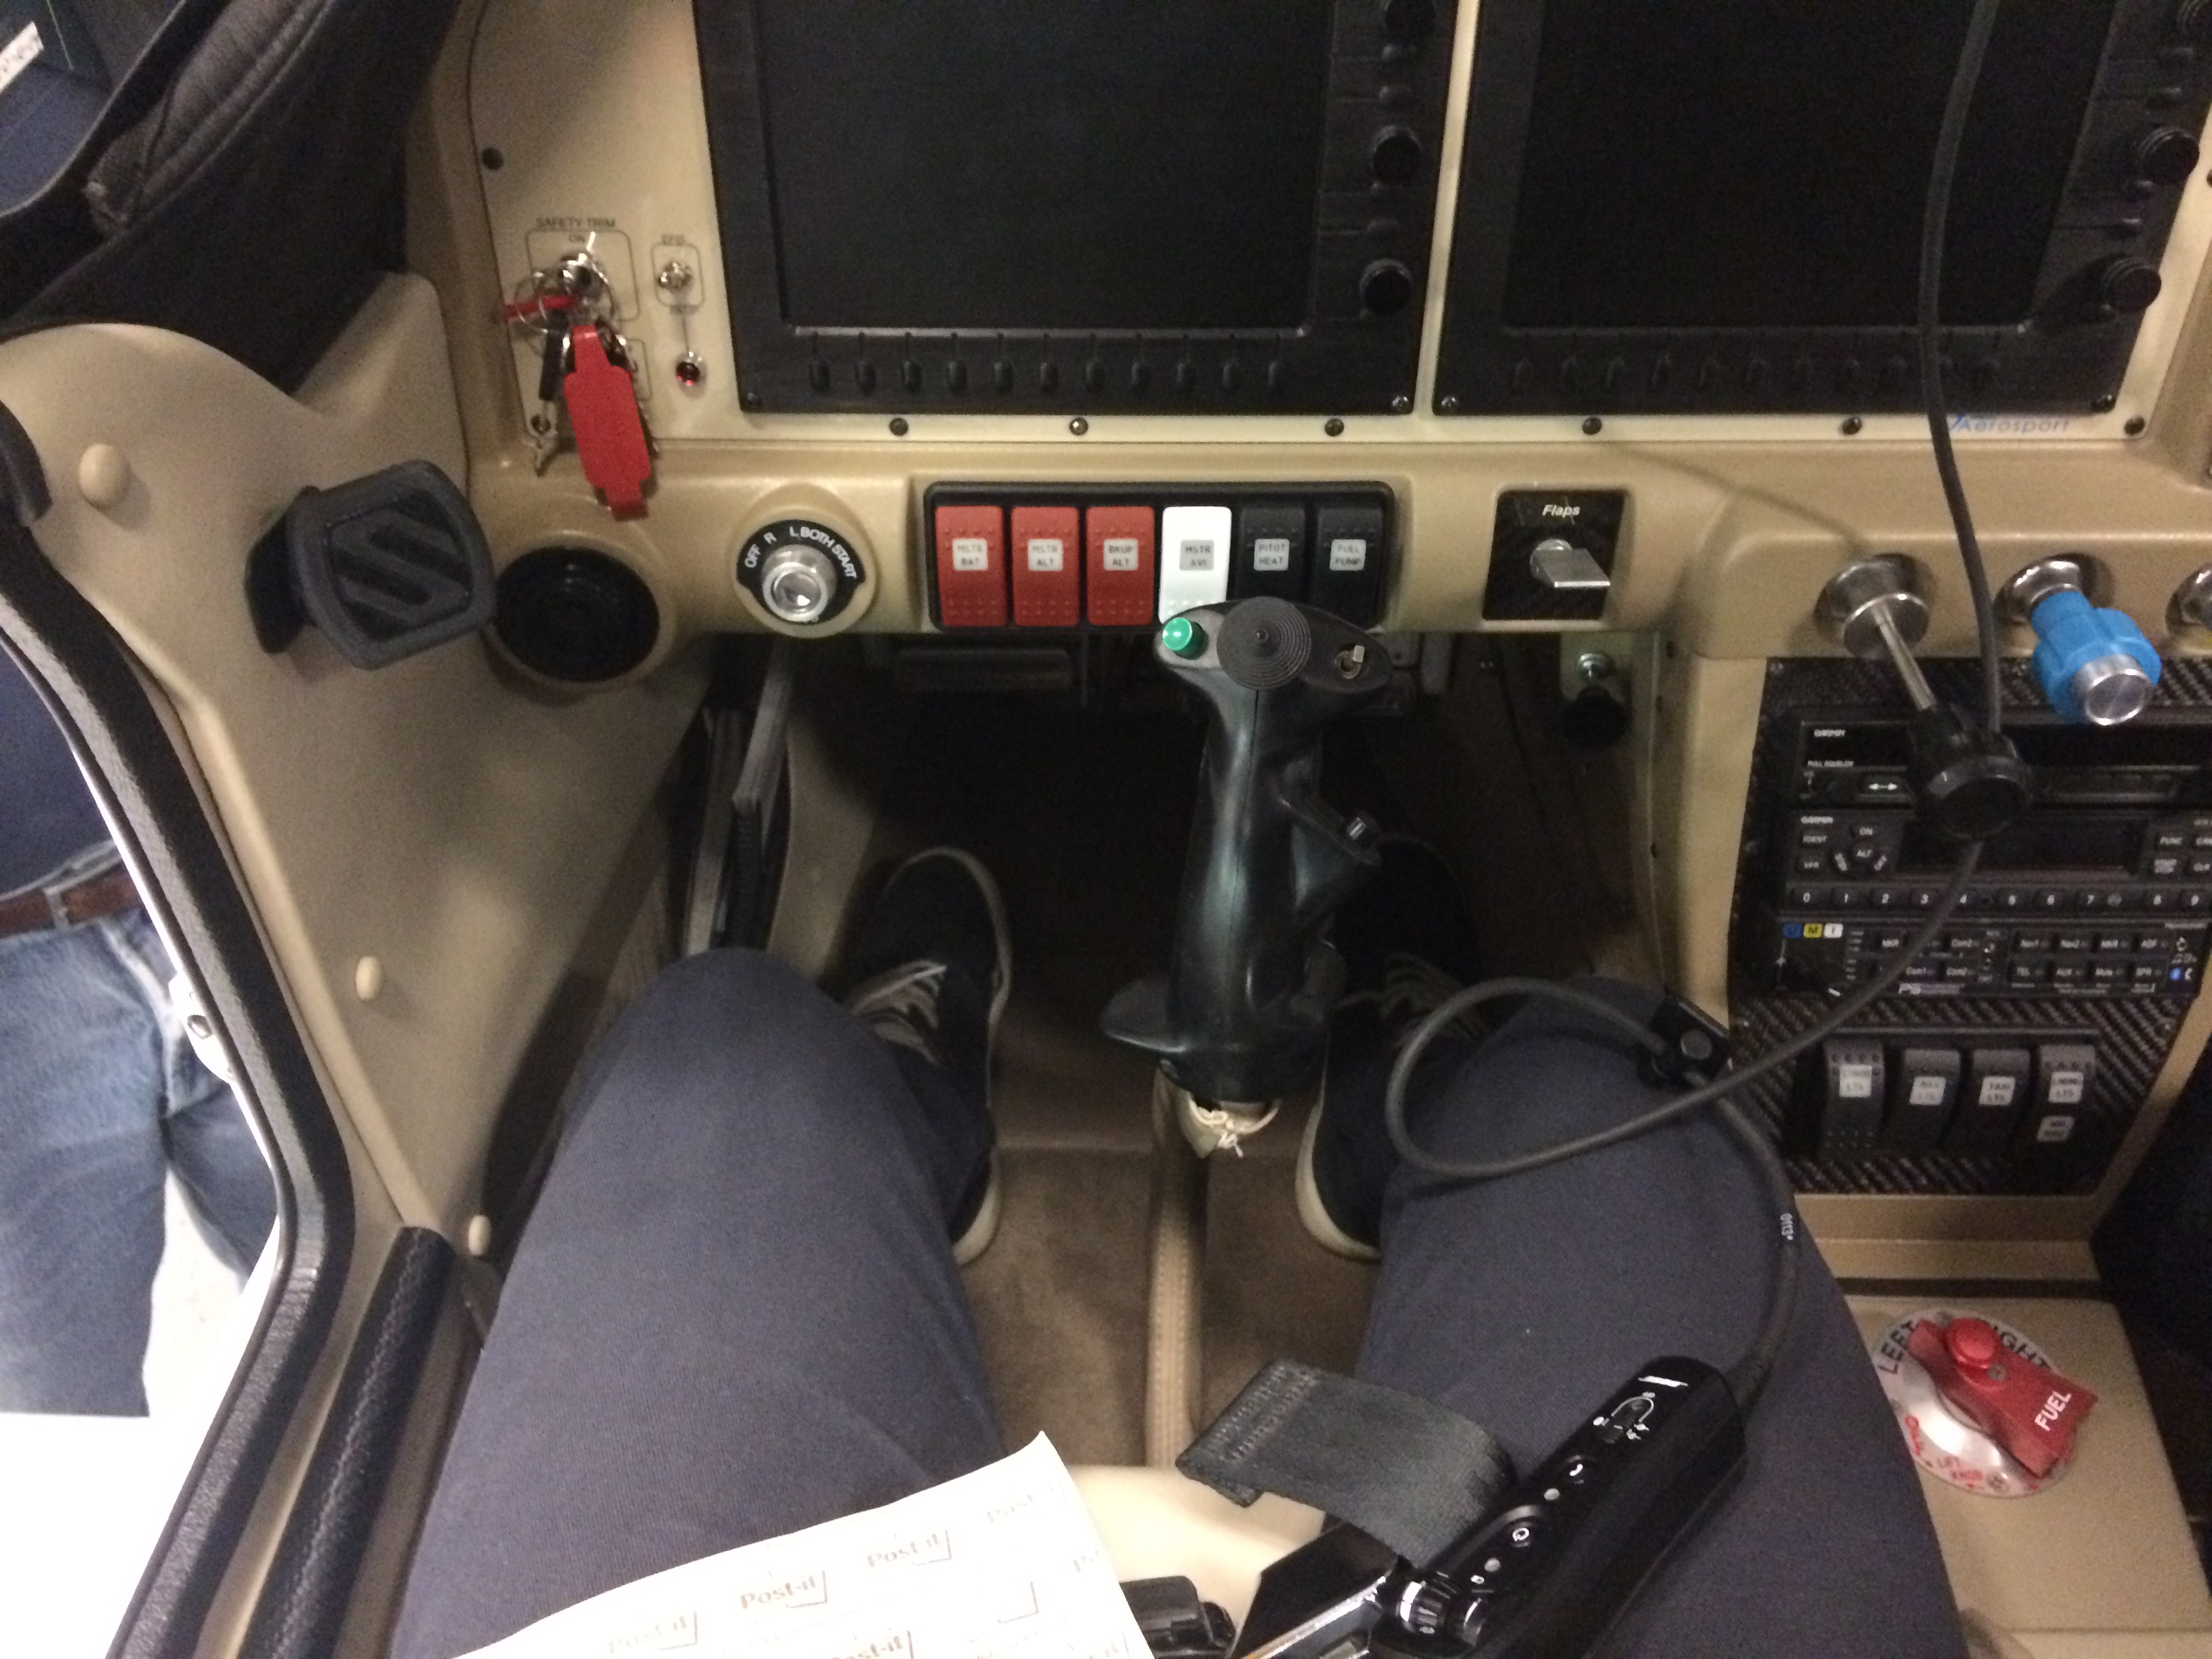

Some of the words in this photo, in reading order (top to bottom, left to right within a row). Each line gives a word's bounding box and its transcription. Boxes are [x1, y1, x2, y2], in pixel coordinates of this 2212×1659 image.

[536, 218, 582, 228] SAFETY
[586, 218, 616, 228] TRIM
[1542, 504, 1580, 518] Flaps
[744, 544, 761, 568] OFF
[763, 532, 777, 544] R
[789, 527, 798, 537] L
[800, 527, 835, 548] BOTH
[832, 544, 857, 579] START
[1185, 545, 1212, 554] MSTR
[961, 558, 980, 567] BAT
[1037, 558, 1054, 567] ALT
[1112, 558, 1130, 567] ALT
[1259, 556, 1284, 565] HEAT
[1803, 892, 1811, 903] 0
[1877, 1319, 1918, 1375] LEFT
[2034, 1391, 2072, 1432] FUEL
[867, 1533, 941, 1568] Post-it
[739, 1574, 817, 1610] Post-it
[832, 1635, 903, 1659] st-it
